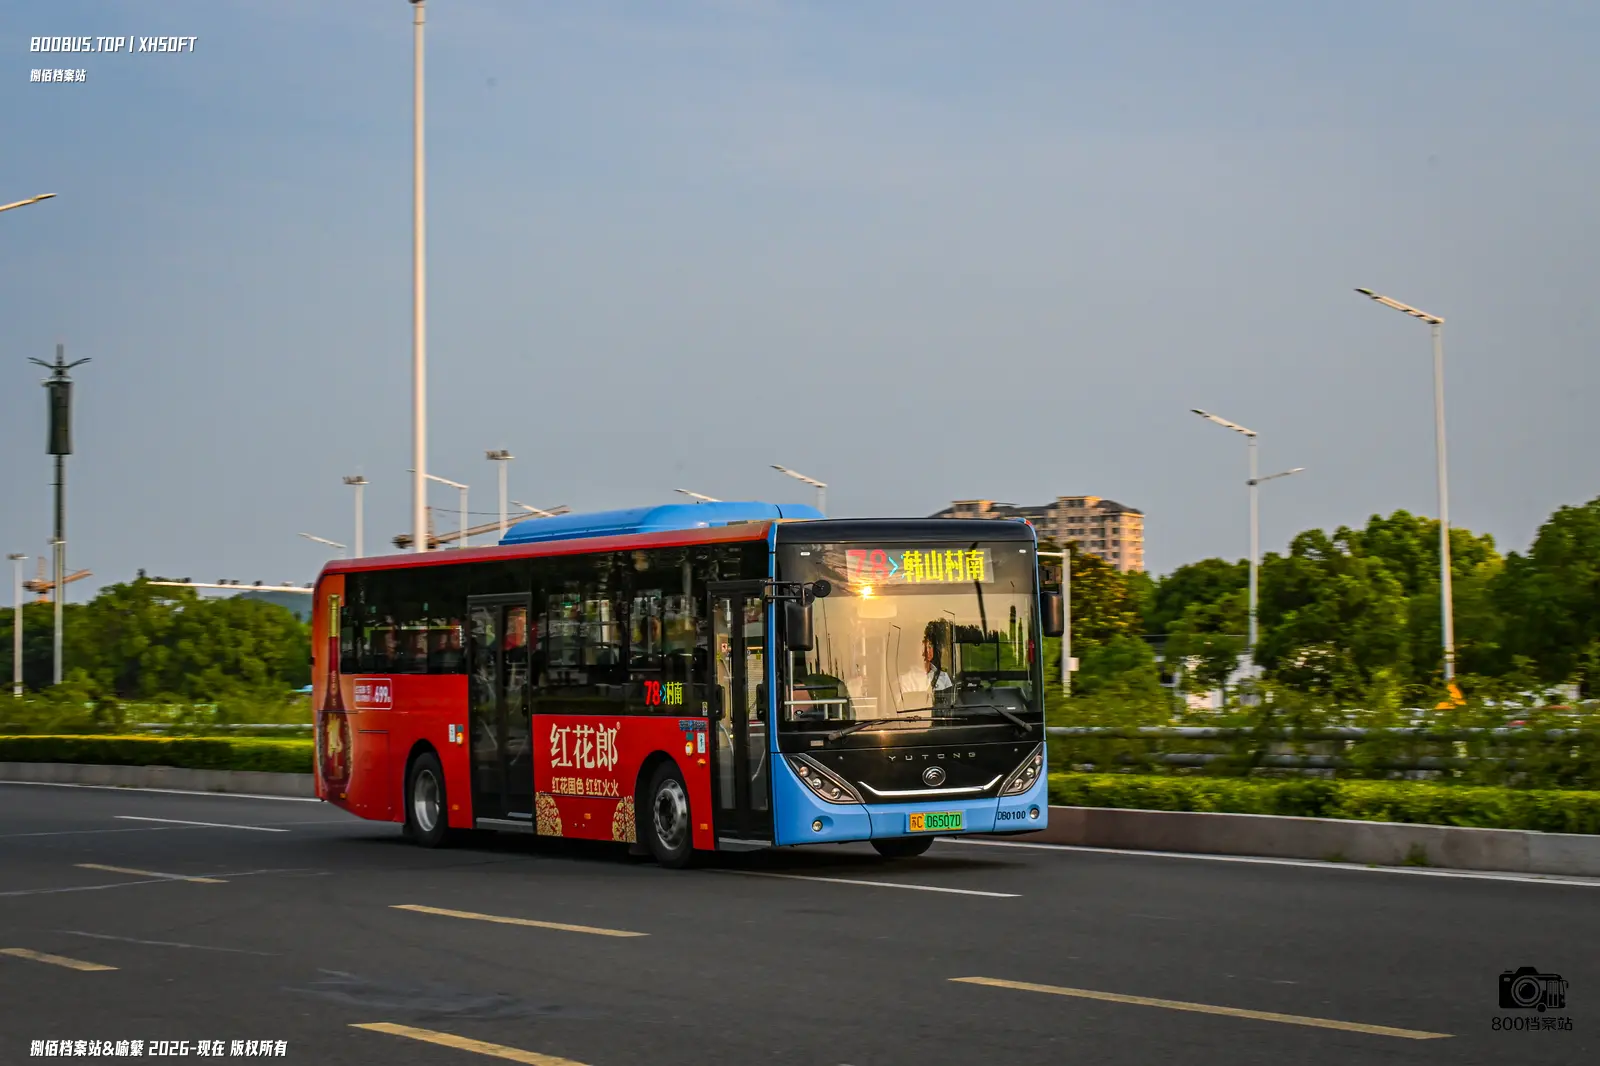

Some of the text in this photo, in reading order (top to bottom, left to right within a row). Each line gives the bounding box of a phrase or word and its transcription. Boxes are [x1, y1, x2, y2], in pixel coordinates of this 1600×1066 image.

[847, 549, 985, 583] 78 韩山村南
[643, 680, 683, 706] 78 村南
[550, 723, 619, 772] 红花郎
[888, 751, 976, 762] YUTONG
[551, 776, 619, 797] 红花国色 红红火火
